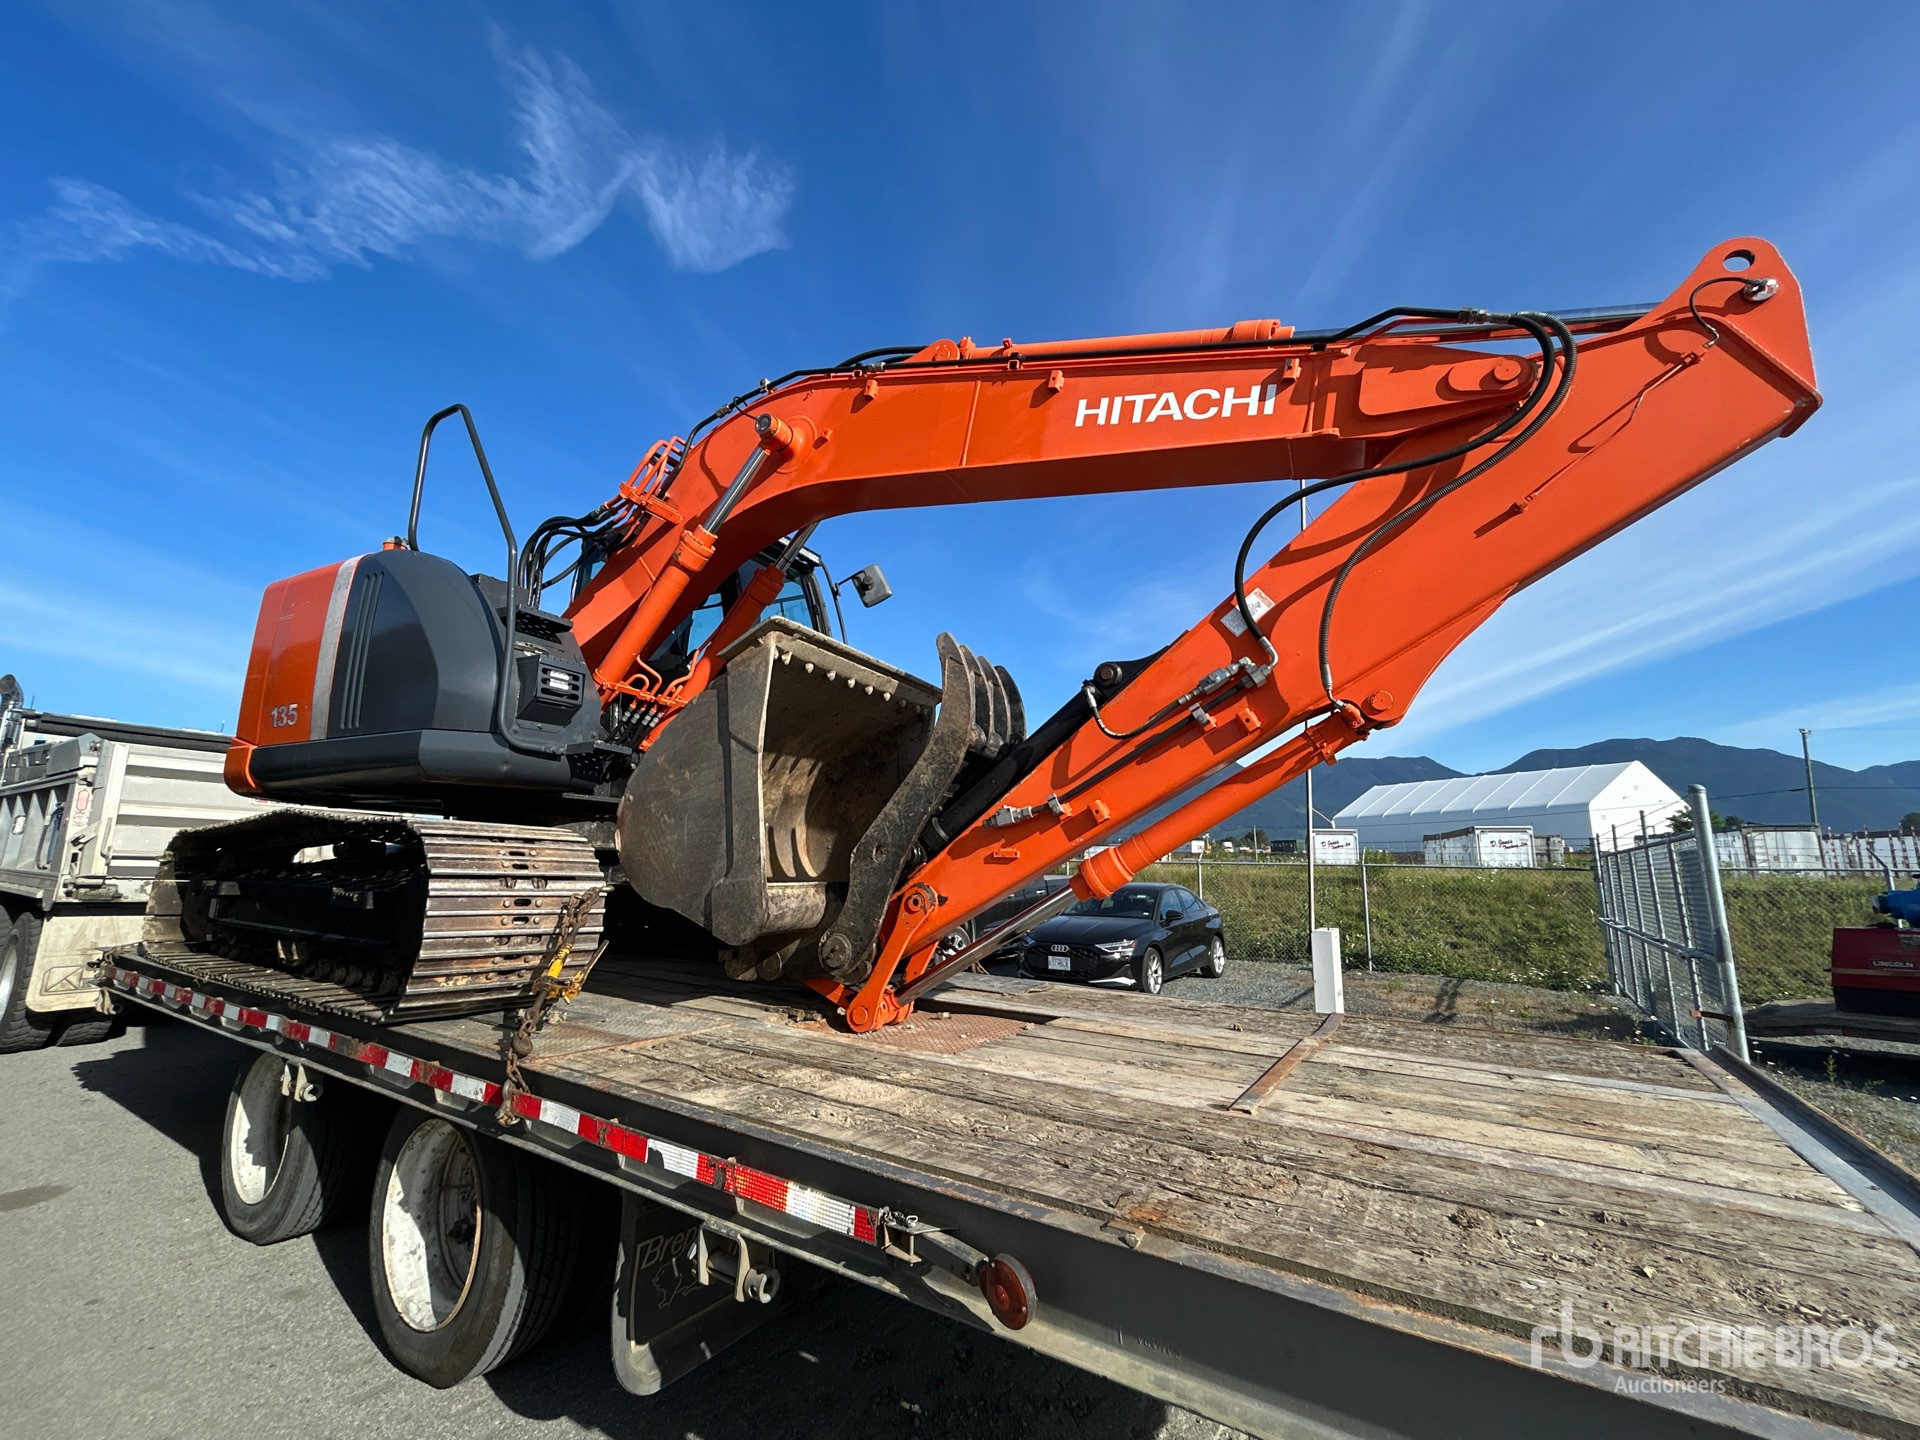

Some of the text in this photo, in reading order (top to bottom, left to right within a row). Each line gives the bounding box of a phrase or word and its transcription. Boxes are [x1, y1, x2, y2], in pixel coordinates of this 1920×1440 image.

[1074, 383, 1278, 427] HITACHI
[271, 703, 299, 728] 135
[1872, 960, 1914, 968] LINCOLN
